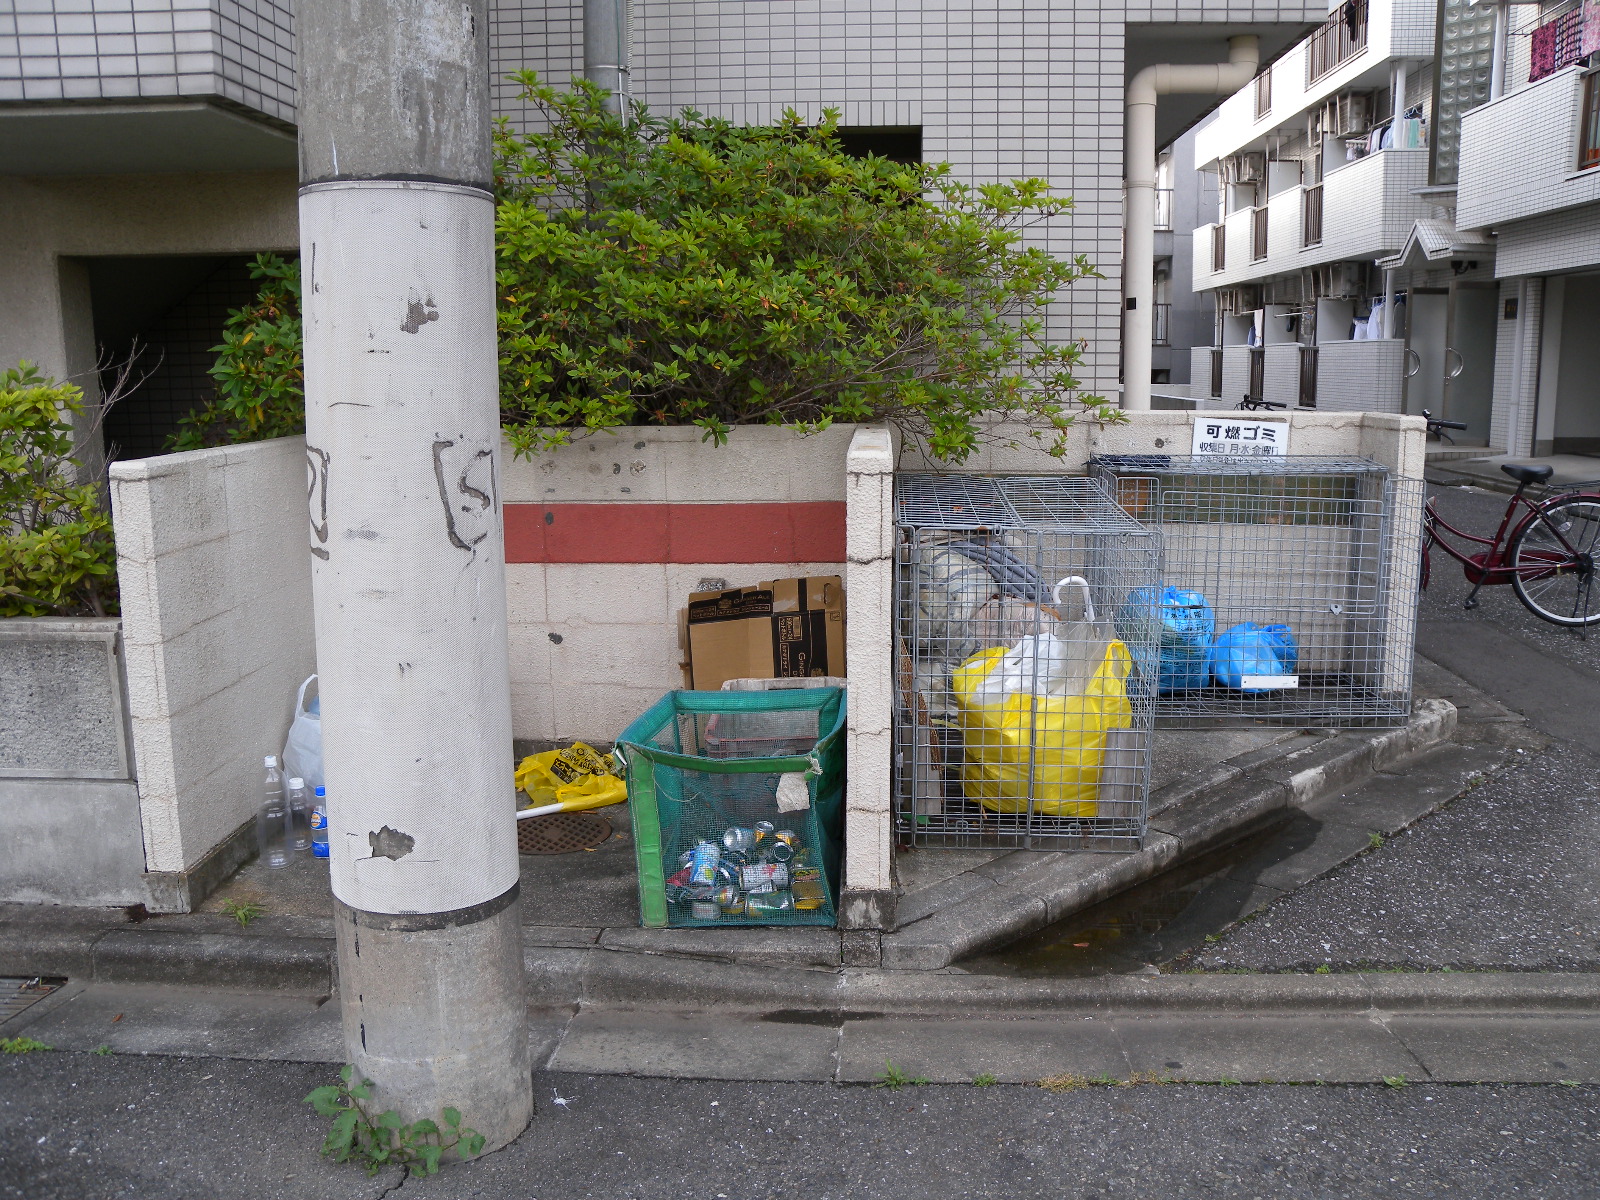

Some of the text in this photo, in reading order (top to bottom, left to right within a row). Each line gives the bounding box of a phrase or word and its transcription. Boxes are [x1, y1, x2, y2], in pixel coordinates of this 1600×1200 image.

[1207, 425, 1276, 443] 可燃ゴミ
[1199, 442, 1225, 453] 収集日
